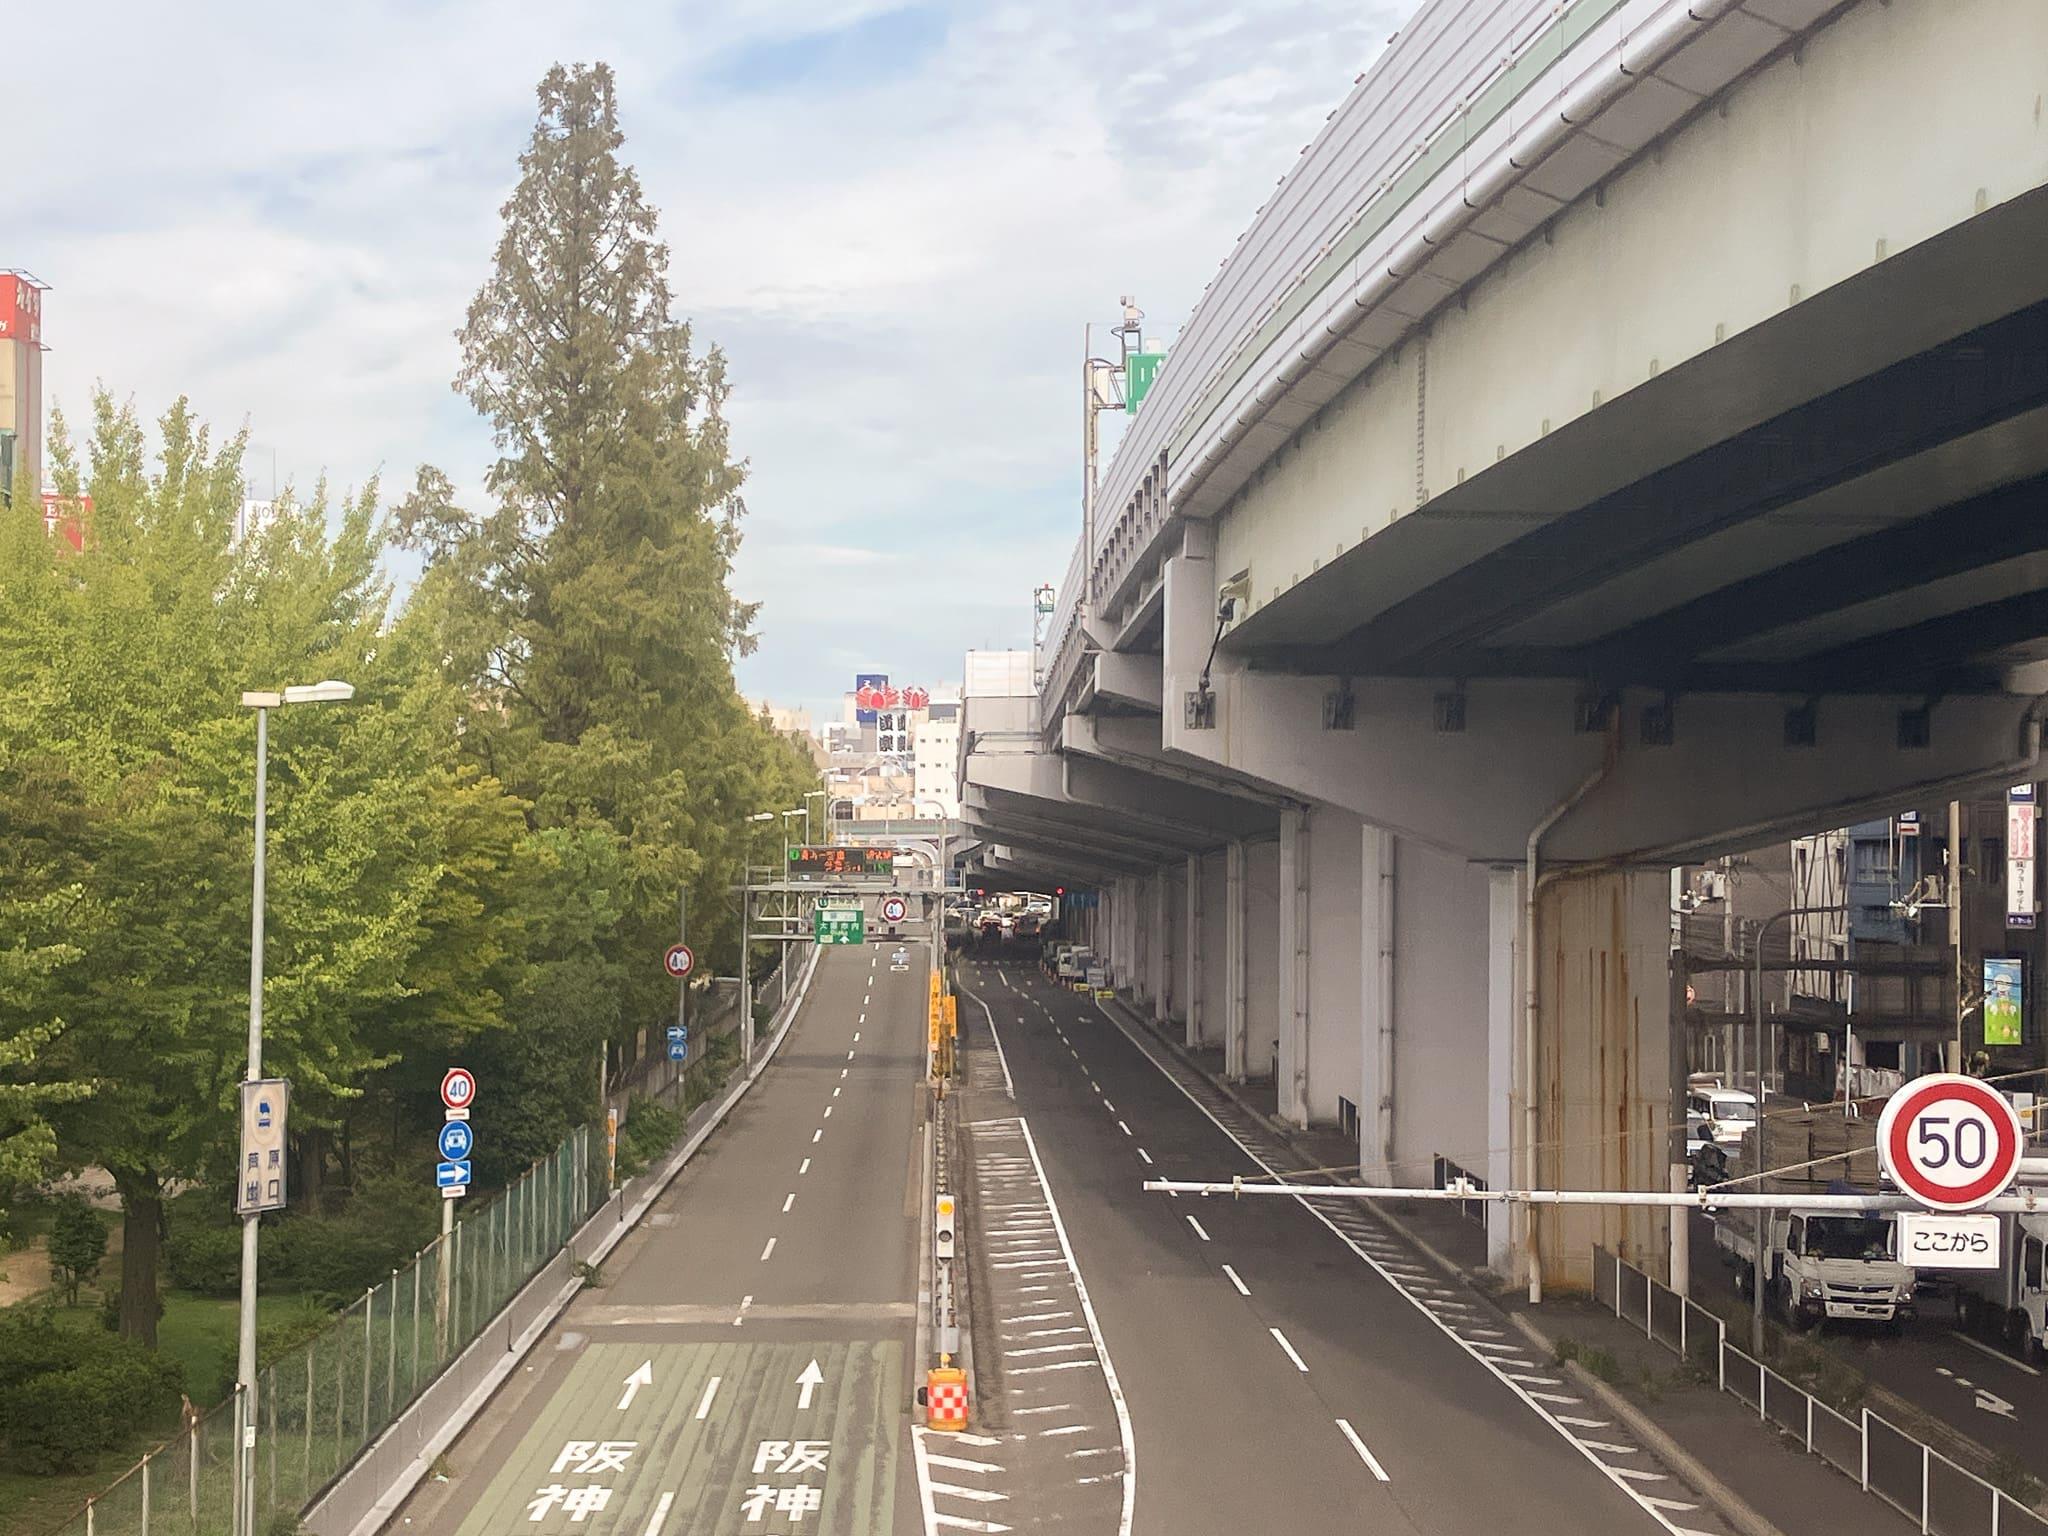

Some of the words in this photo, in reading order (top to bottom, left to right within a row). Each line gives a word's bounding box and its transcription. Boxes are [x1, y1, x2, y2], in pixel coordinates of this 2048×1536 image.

[449, 1081, 467, 1097] 40
[1919, 1117, 1986, 1169] 50
[246, 1179, 279, 1201] 出口
[1913, 1231, 1989, 1253] ここから
[526, 1440, 639, 1522] 阪神
[740, 1440, 831, 1522] 阪神
